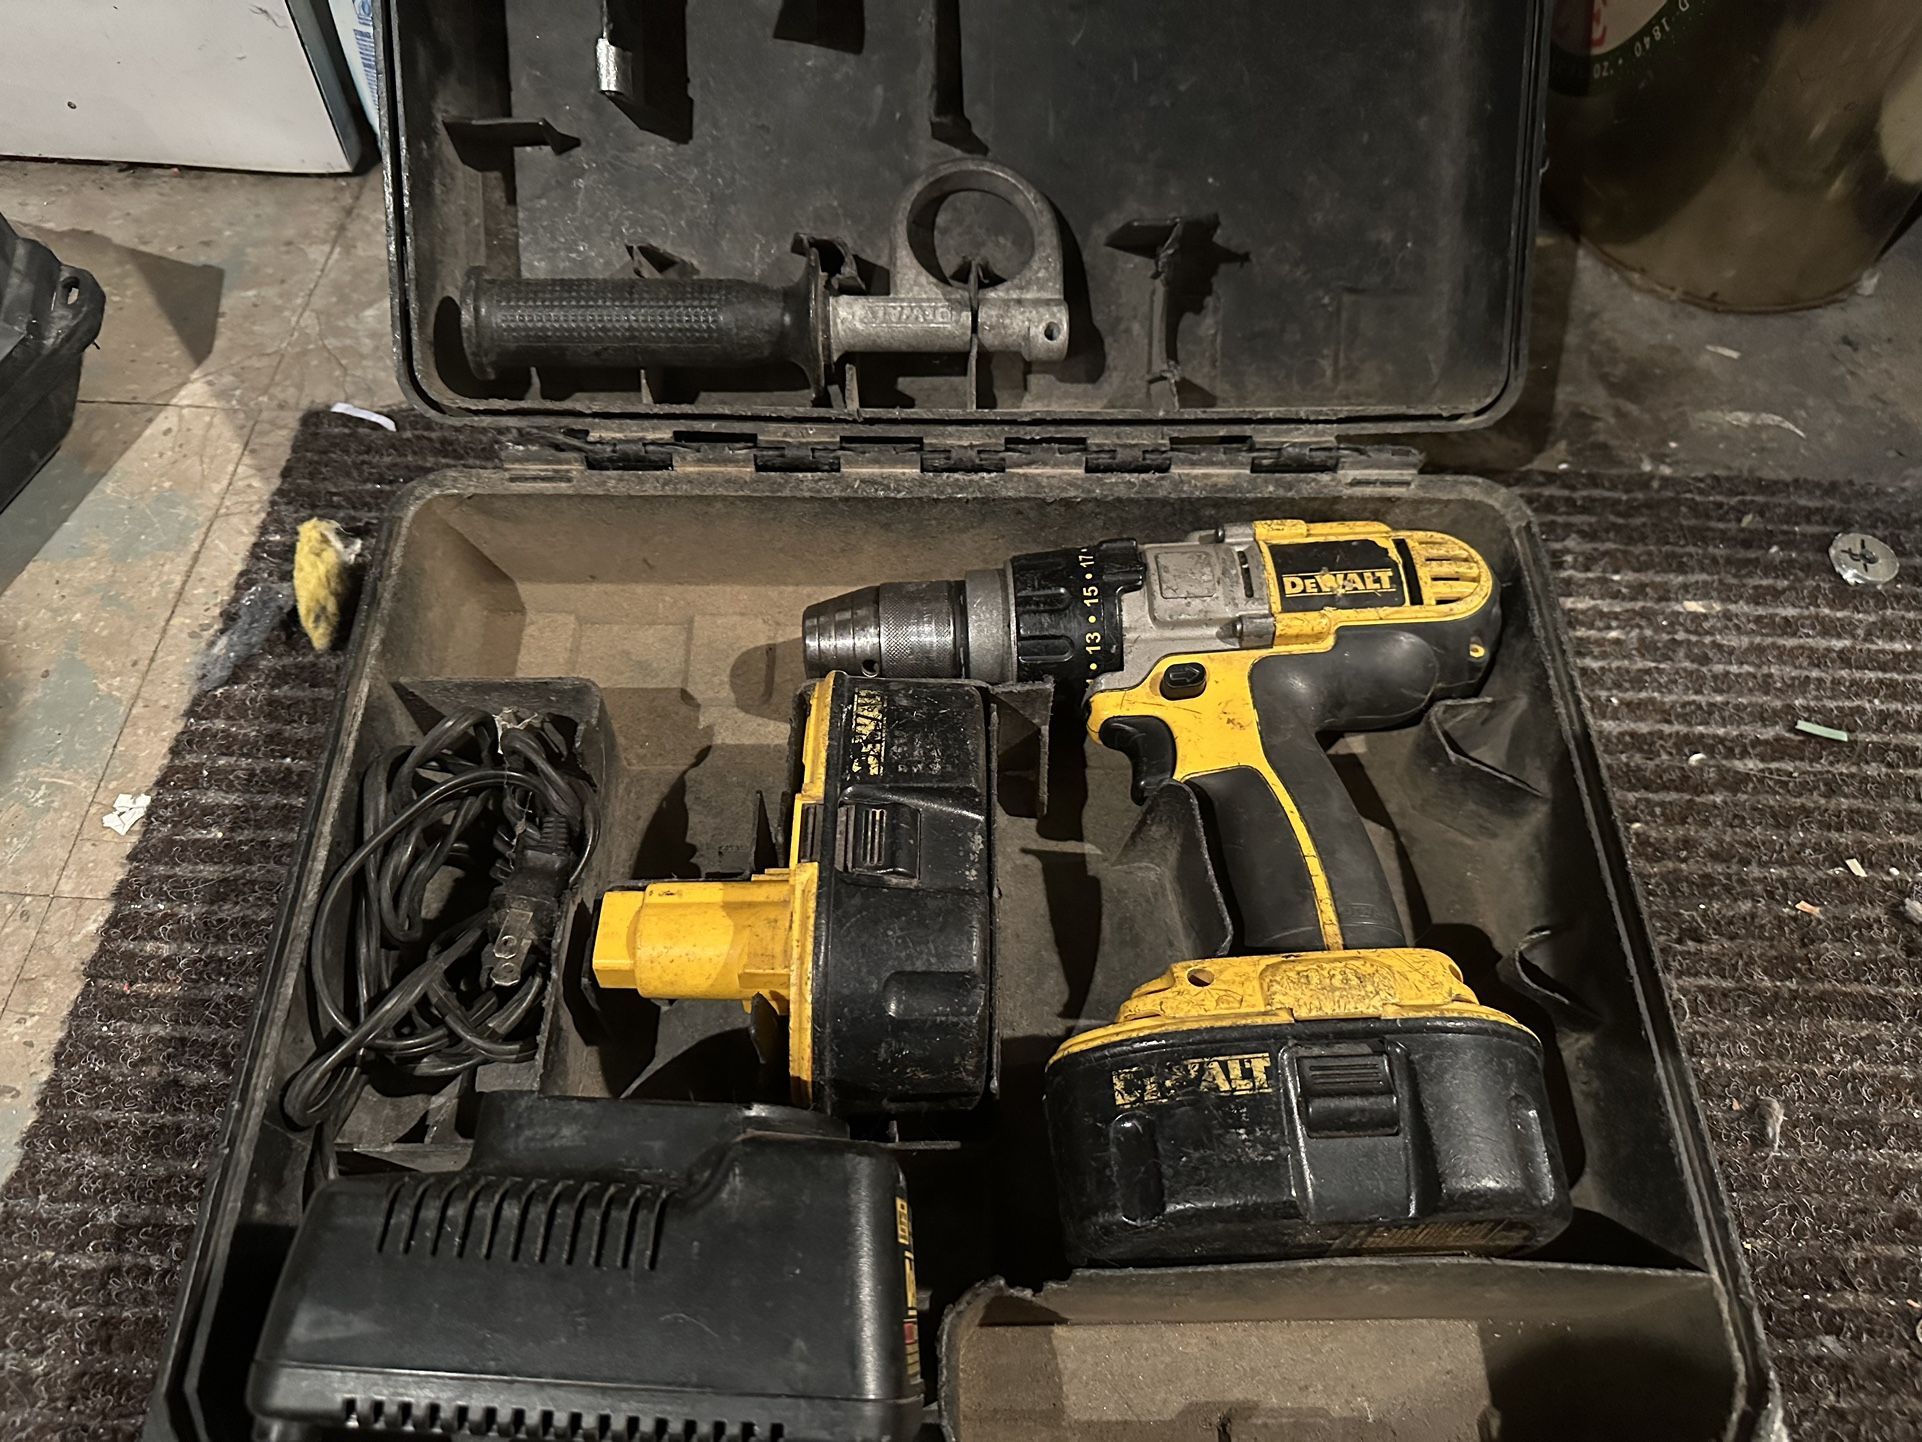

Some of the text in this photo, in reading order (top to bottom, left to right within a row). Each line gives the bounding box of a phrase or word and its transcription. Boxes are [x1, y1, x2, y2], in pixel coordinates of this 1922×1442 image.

[1633, 17, 1671, 57] 1840
[1078, 554, 1102, 655] 13 15 17
